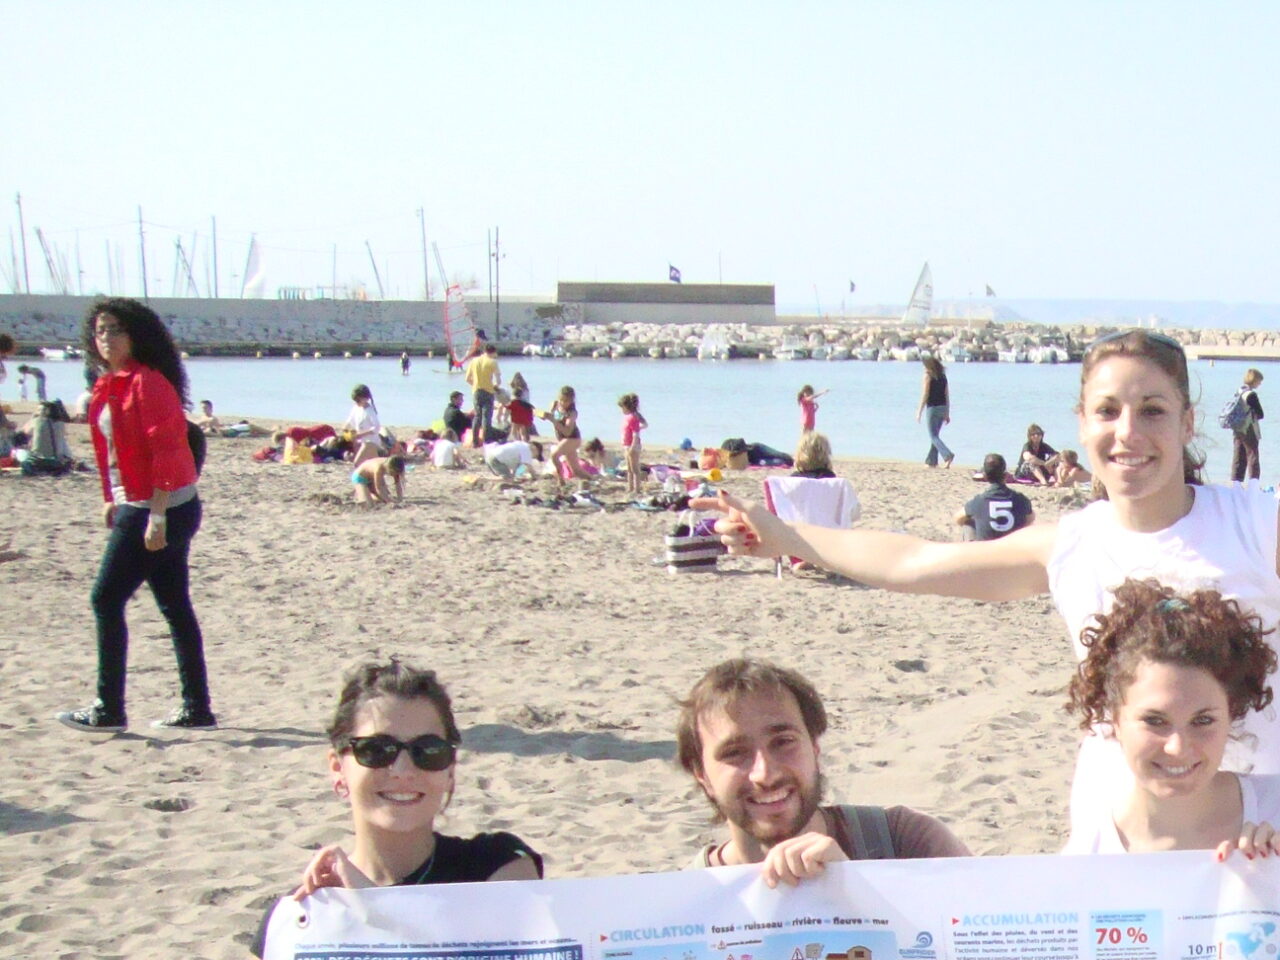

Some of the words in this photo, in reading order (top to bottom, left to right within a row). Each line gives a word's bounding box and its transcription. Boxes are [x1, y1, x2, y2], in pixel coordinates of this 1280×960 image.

[989, 501, 1014, 532] 5
[963, 912, 1079, 927] ACCUMULATION
[611, 924, 705, 942] CIRCULATION
[712, 923, 734, 934] fossé
[744, 920, 783, 932] ruisseau
[792, 917, 822, 929] rivière
[833, 917, 862, 927] fleuve
[873, 919, 889, 928] mer
[1095, 928, 1122, 944] 70
[1127, 927, 1148, 944] %
[1187, 943, 1203, 955] 10
[1205, 944, 1217, 954] m
